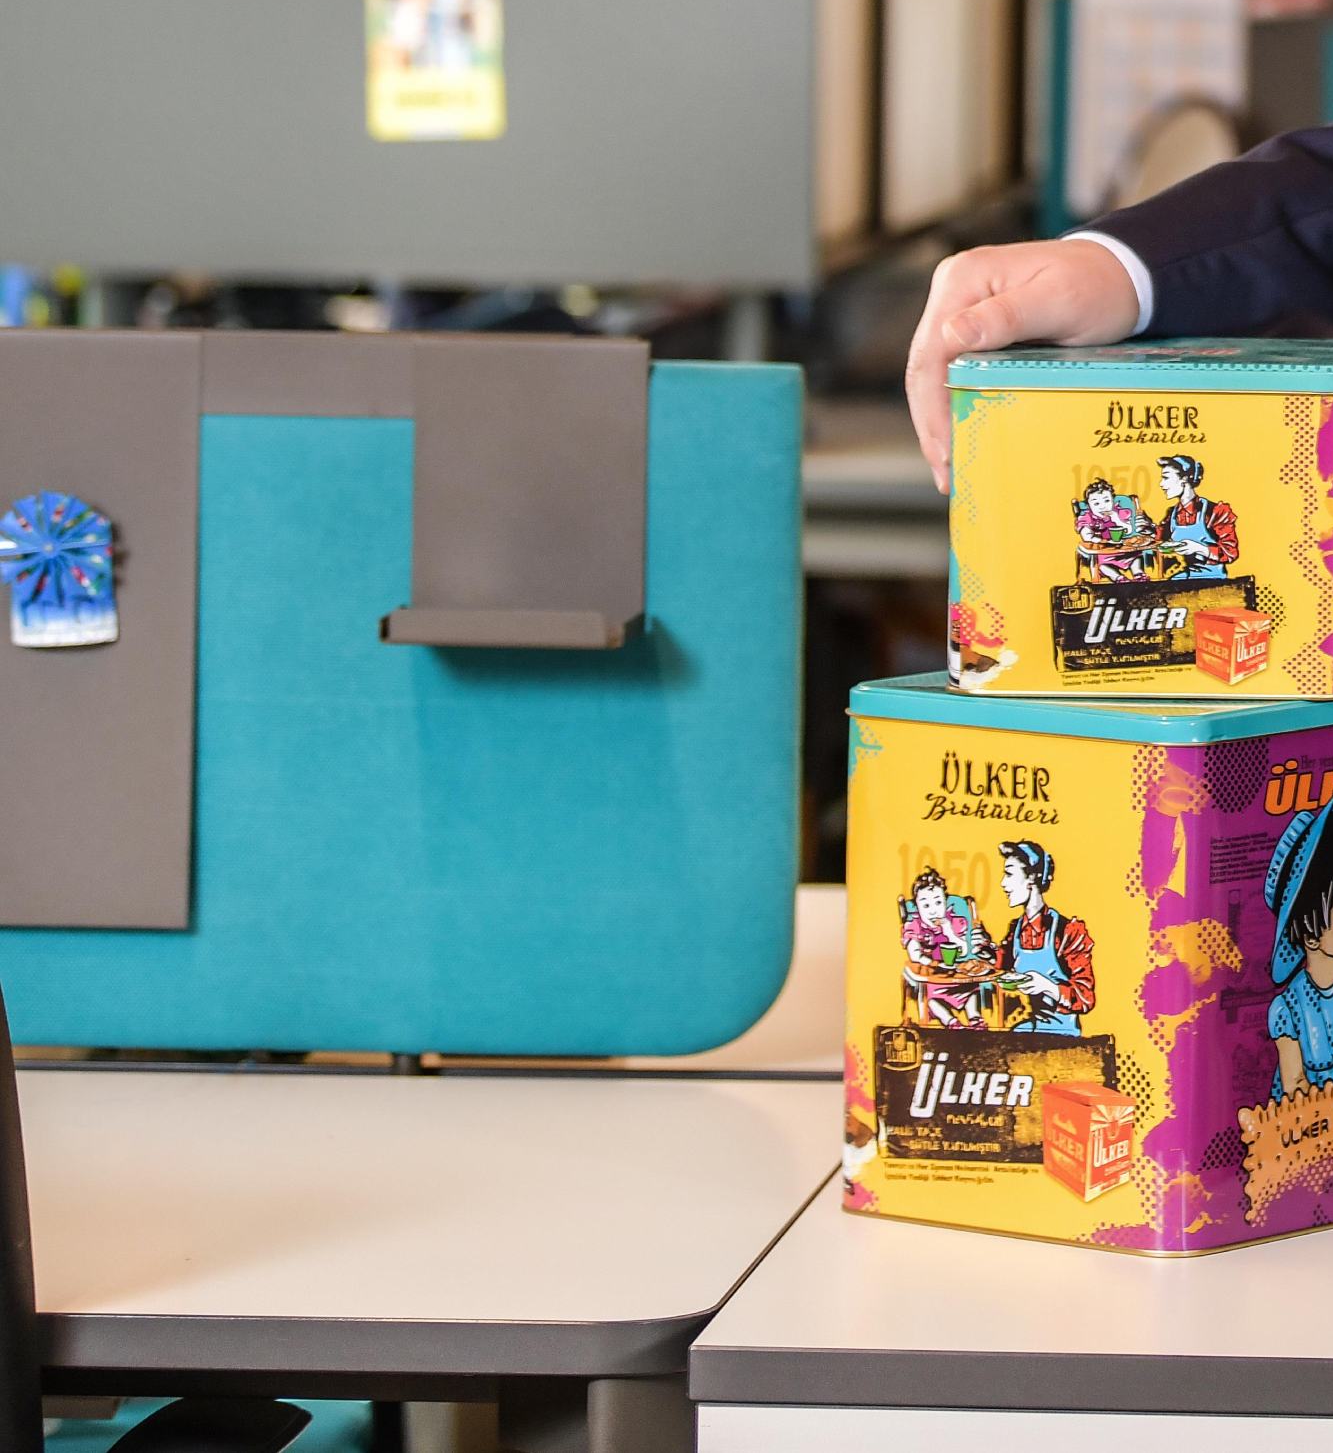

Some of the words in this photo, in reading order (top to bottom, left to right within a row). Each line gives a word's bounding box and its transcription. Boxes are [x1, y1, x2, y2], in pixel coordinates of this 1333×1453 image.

[1106, 400, 1199, 430] ÜLKER
[1084, 598, 1188, 643] ÜLKER
[940, 750, 1050, 802] ÜLKER
[909, 1051, 1034, 1118] ÜLKER
